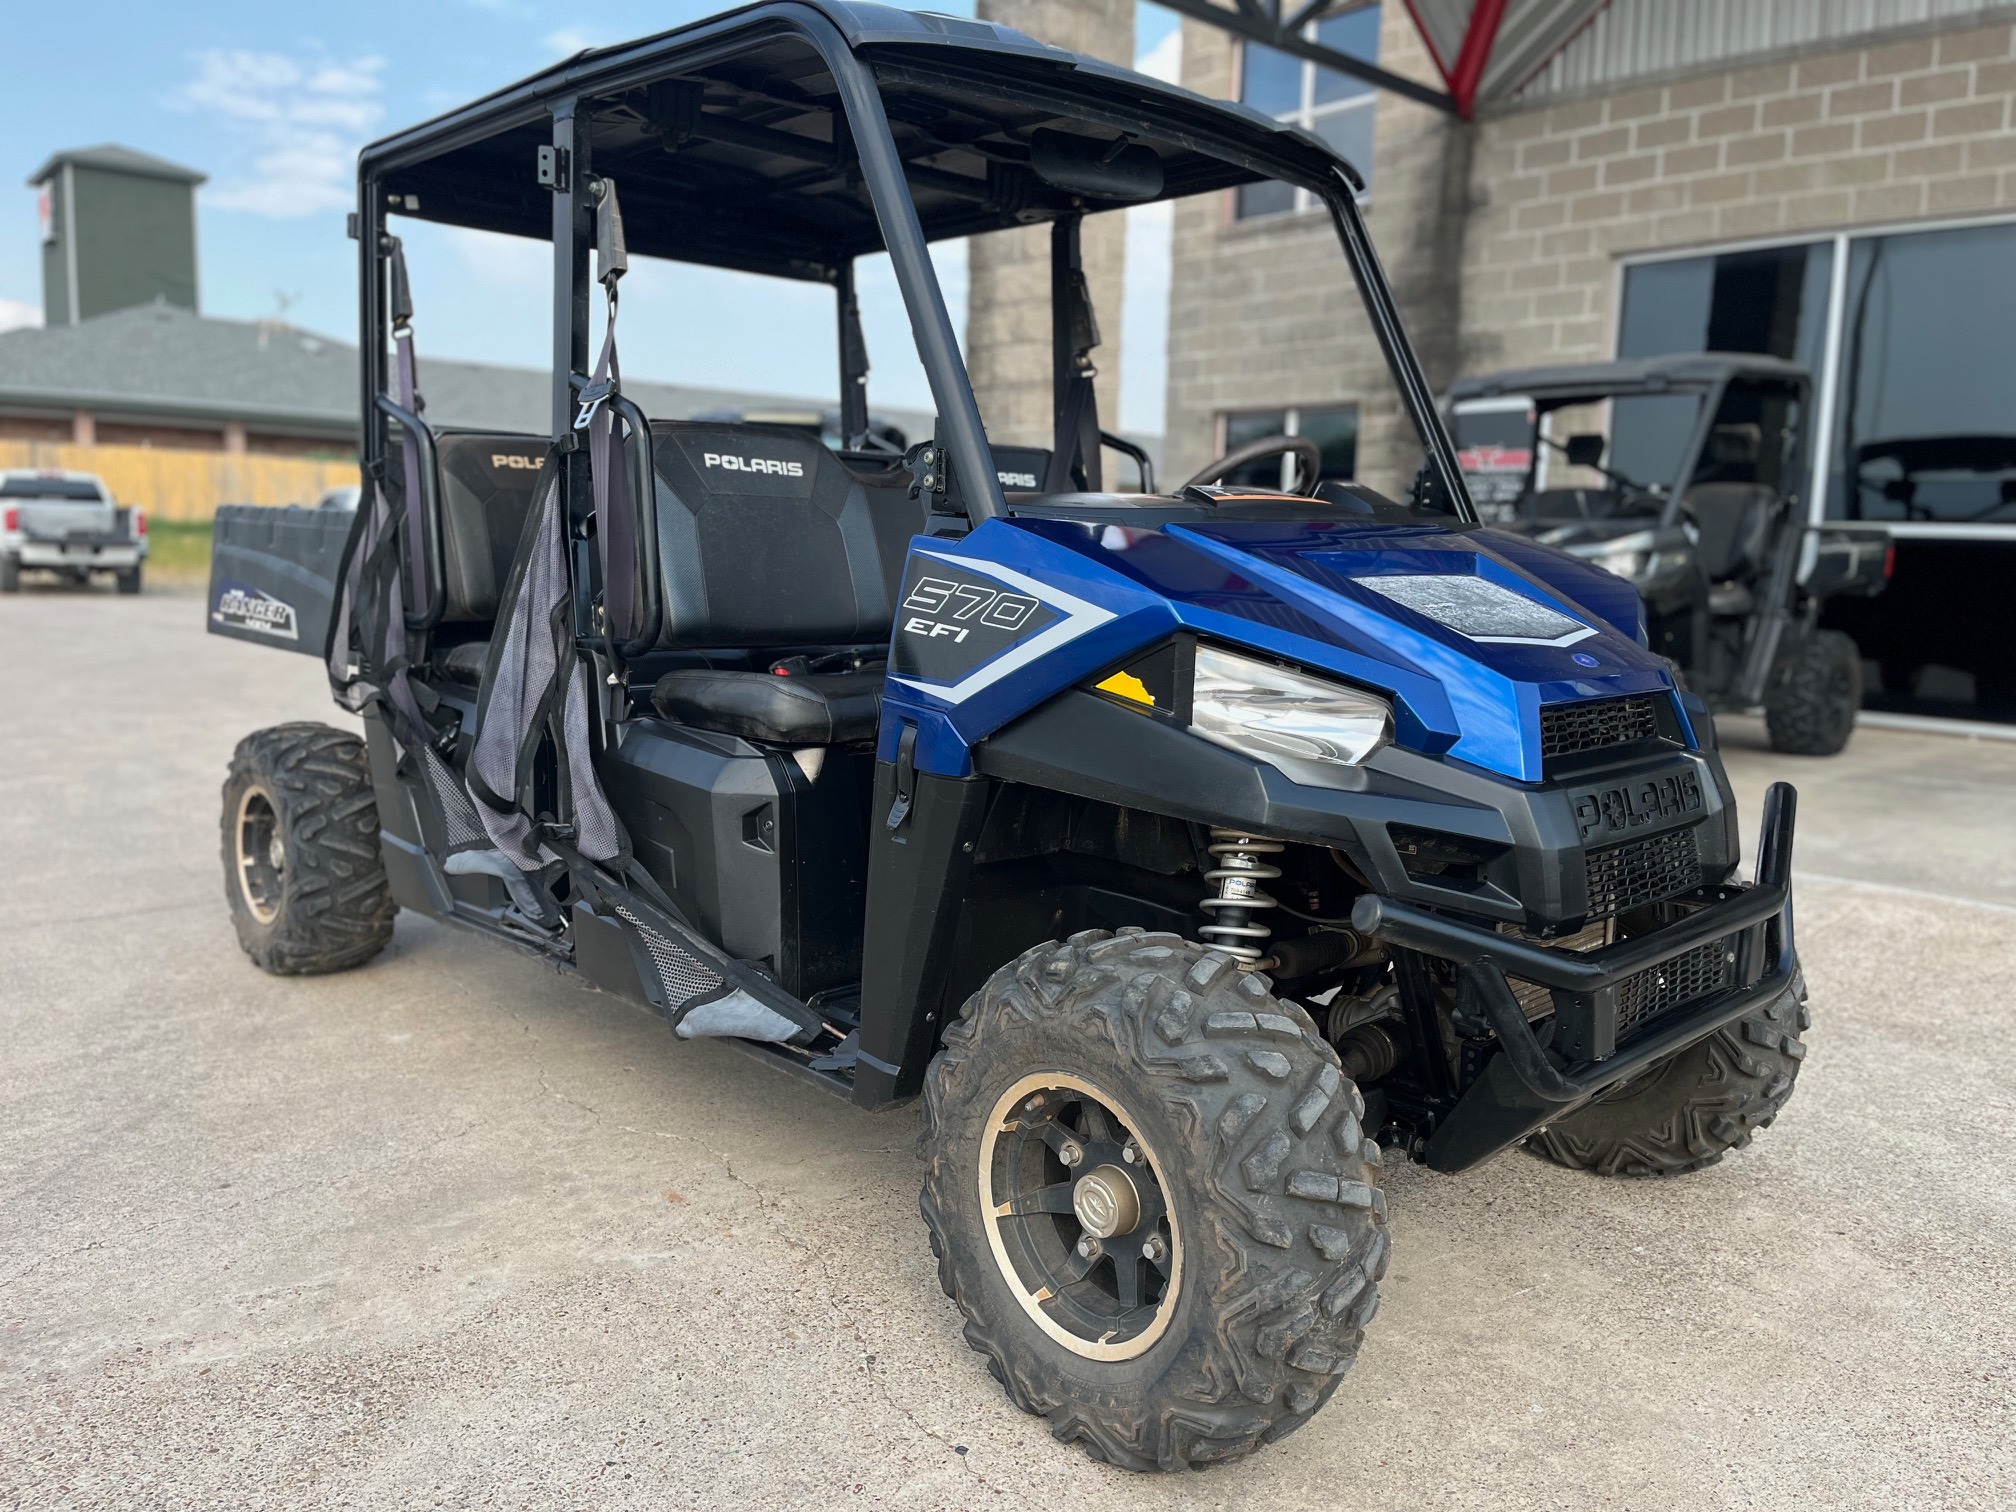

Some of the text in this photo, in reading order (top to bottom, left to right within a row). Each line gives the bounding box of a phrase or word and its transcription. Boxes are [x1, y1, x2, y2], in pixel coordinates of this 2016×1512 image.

[704, 453, 803, 477] POLARIS
[903, 576, 1039, 631] 570
[904, 617, 970, 643] EFI
[1575, 771, 1700, 838] POLARIS
